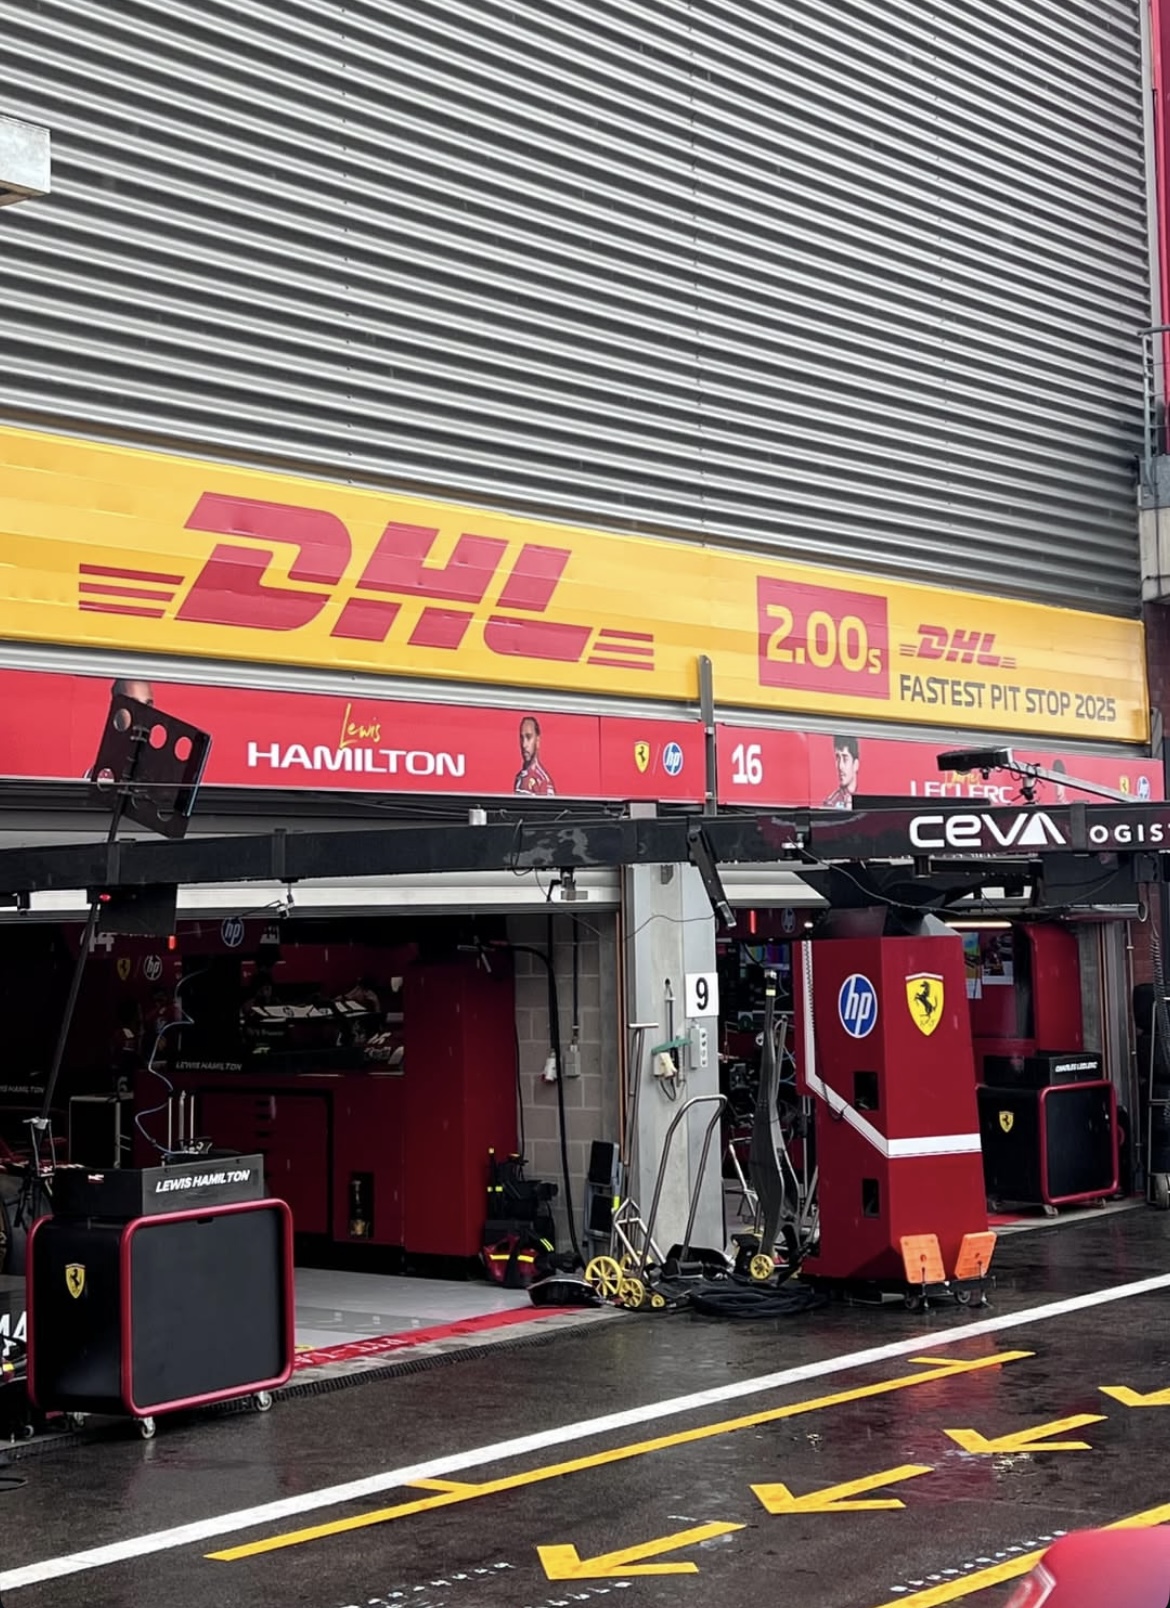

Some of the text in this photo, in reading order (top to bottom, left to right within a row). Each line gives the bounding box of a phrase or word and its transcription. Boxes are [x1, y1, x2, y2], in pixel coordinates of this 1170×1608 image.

[175, 491, 594, 662] DHL
[916, 623, 1001, 667] DHL
[899, 674, 1117, 723] FASTEST PIT STOP 2025
[338, 702, 381, 749] Lewis
[247, 742, 467, 778] HAMILTON
[663, 742, 684, 777] hp
[731, 743, 764, 785] 16
[1088, 822, 1170, 844] OGIS
[695, 976, 709, 1011] 9
[840, 975, 876, 1037] hp
[156, 1169, 251, 1193] LEWIS HAMILTON
